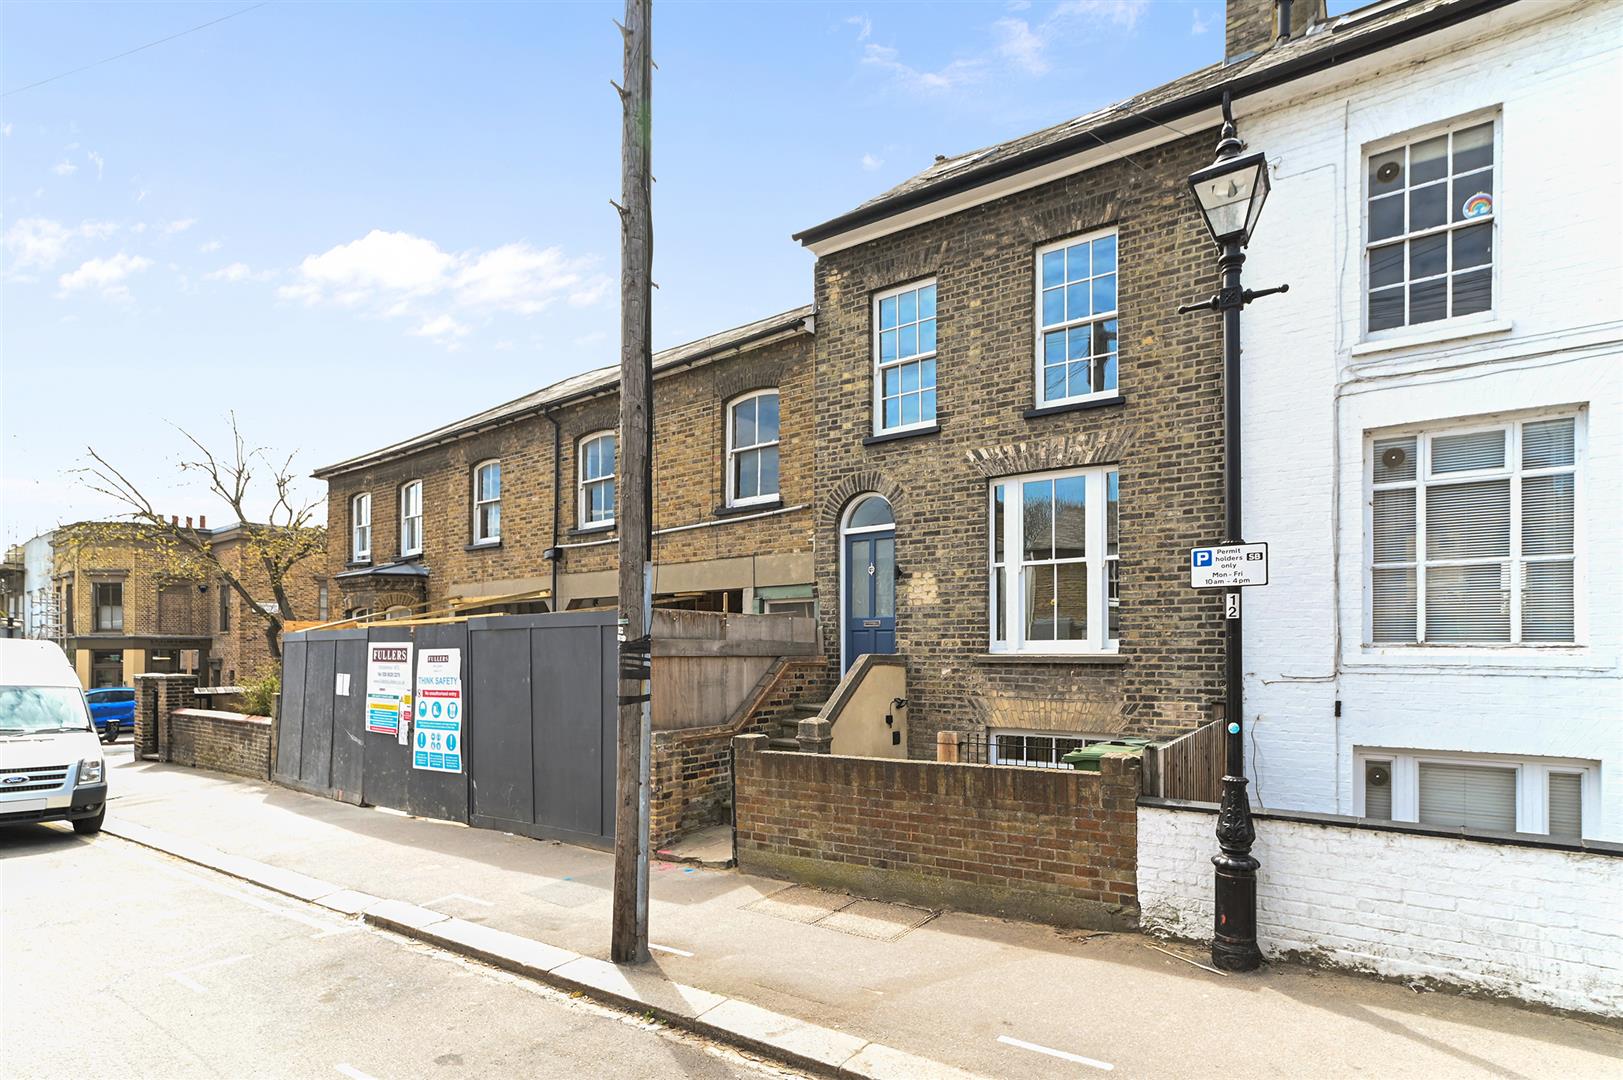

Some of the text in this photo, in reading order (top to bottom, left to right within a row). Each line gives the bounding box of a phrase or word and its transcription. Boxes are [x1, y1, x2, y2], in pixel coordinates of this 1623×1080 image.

[1248, 552, 1261, 560] SB
[373, 649, 407, 661] FULLERS
[418, 676, 458, 685] THINK SAFETY
